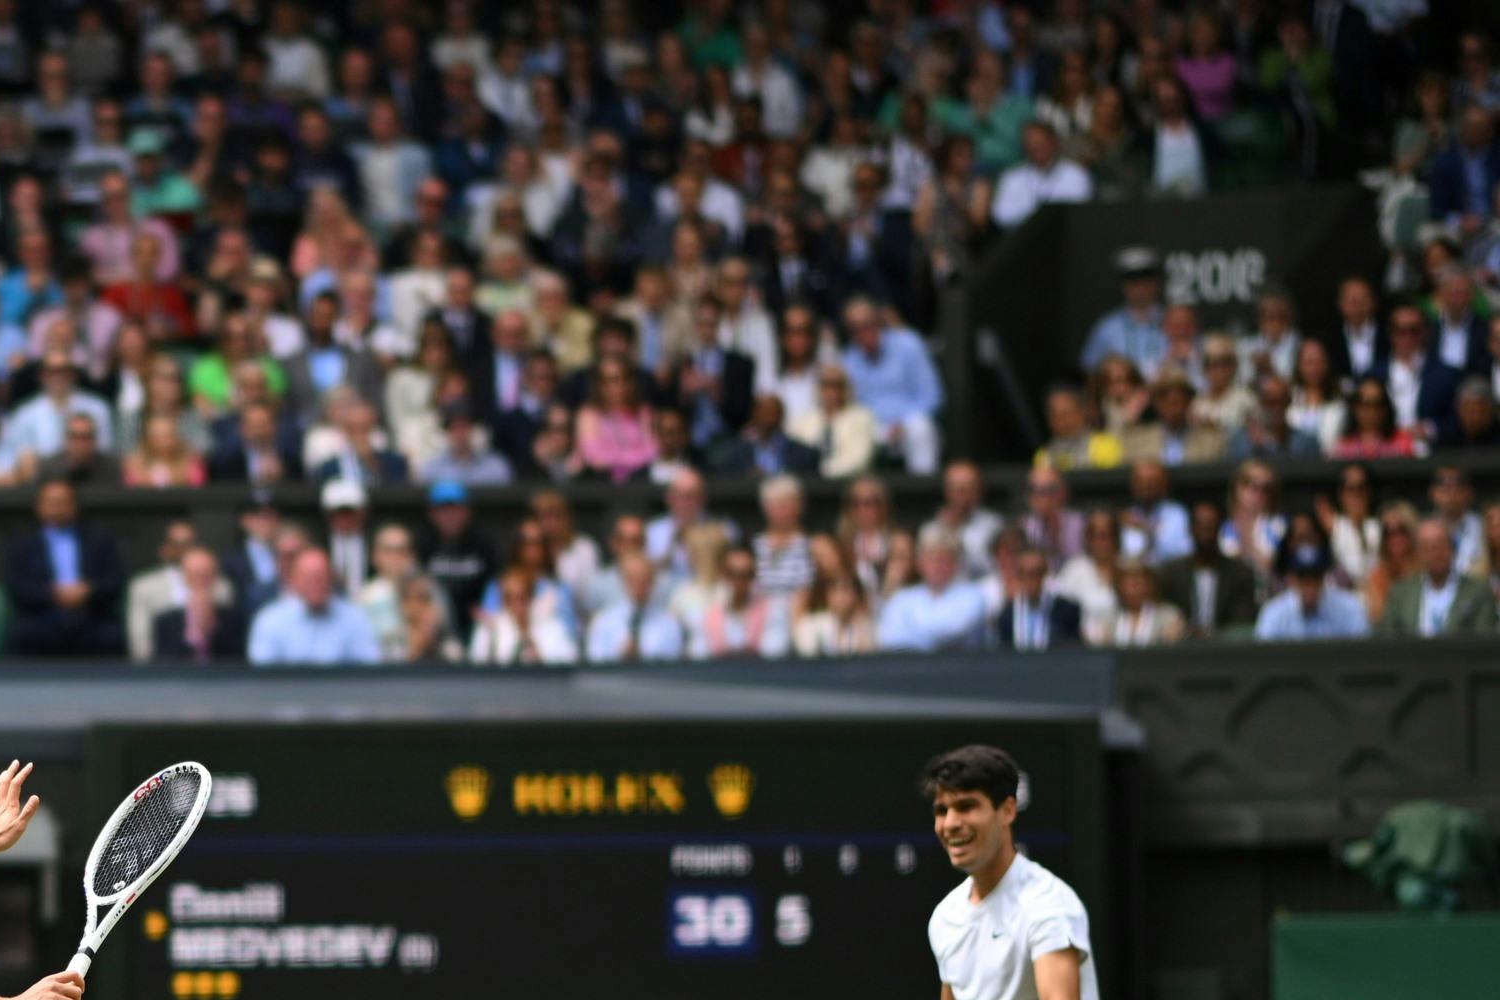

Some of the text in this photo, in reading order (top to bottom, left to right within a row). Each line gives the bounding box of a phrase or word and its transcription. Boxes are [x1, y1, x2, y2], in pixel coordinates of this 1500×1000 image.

[514, 774, 684, 814] ROLEX
[674, 897, 810, 944] 30 5
[171, 927, 396, 966] MEDVEDEV
